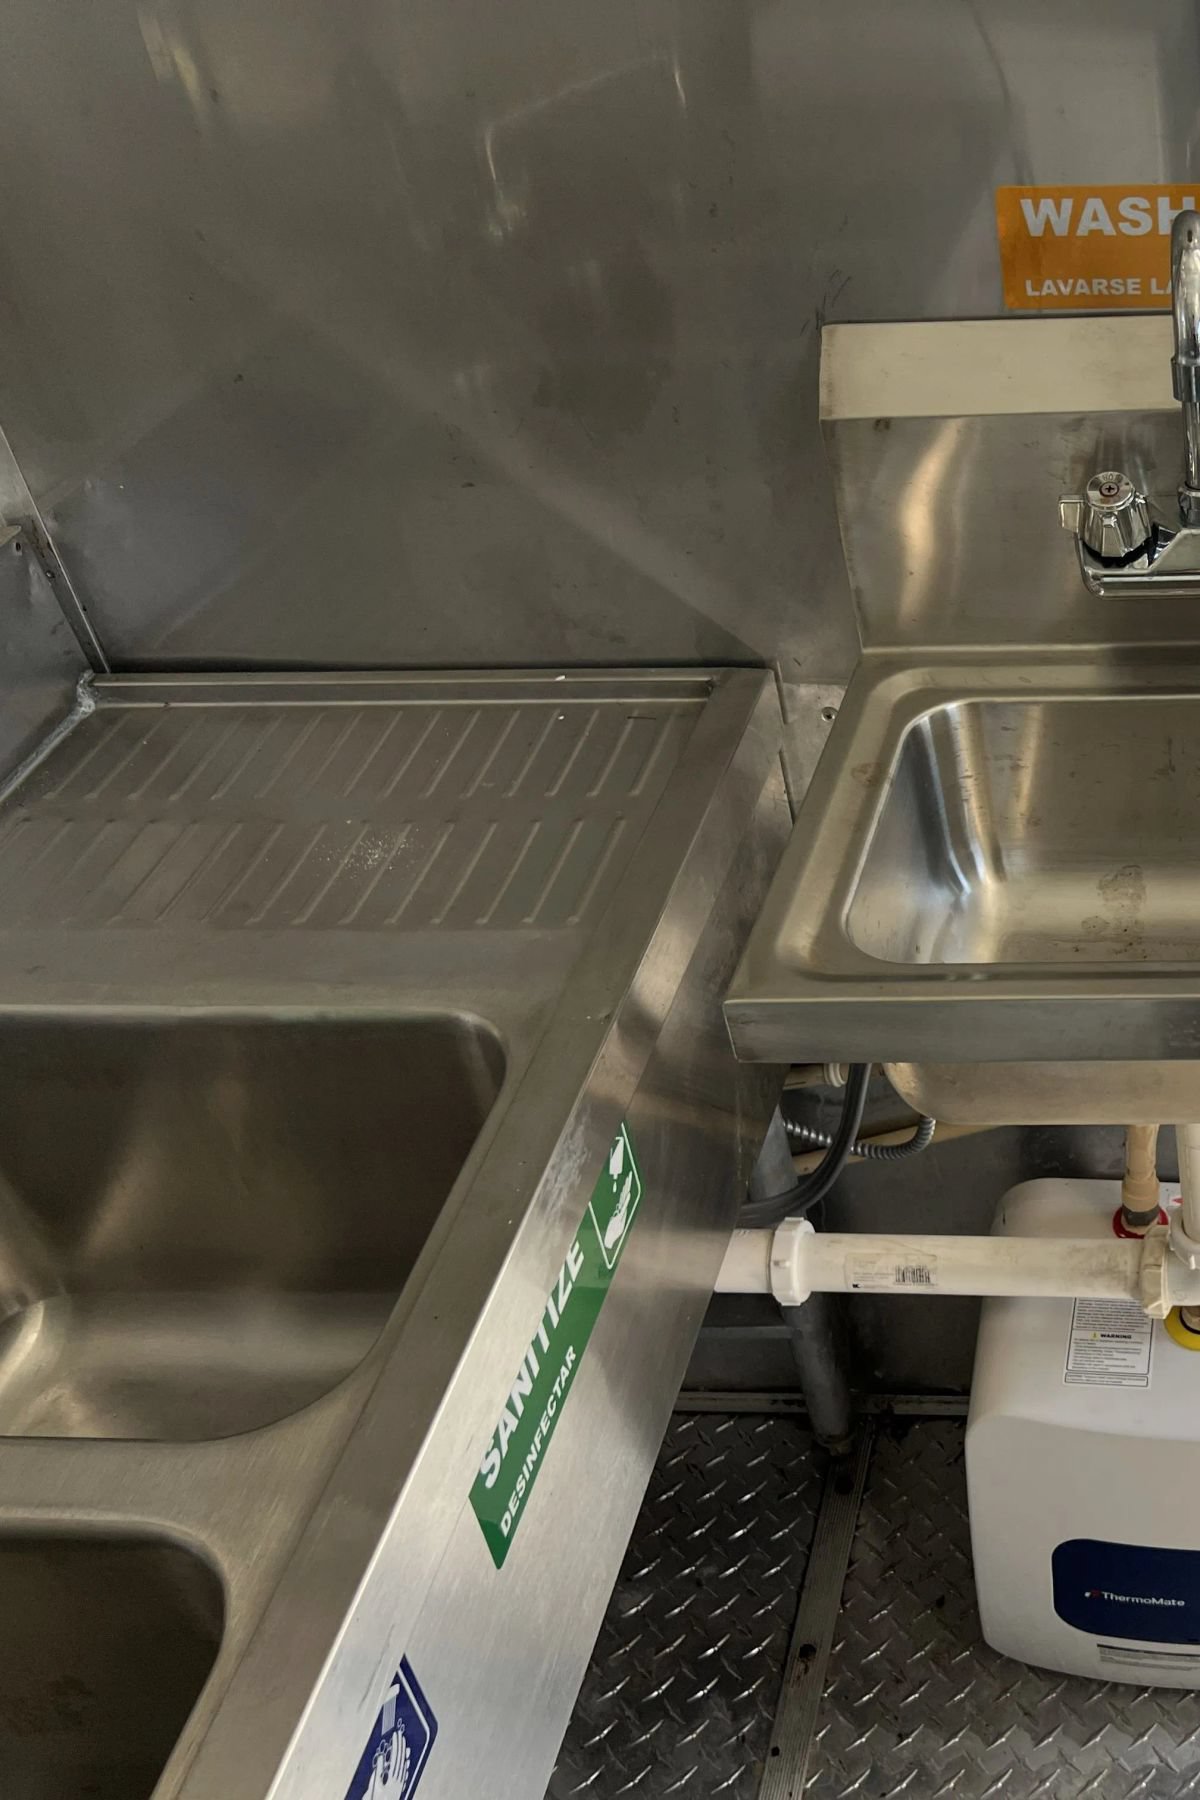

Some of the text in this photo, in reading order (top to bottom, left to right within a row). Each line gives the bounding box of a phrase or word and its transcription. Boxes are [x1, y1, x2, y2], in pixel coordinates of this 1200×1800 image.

[1020, 197, 1195, 237] WASH
[1025, 277, 1142, 297] LAVARSE
[480, 1239, 586, 1489] SANITIZE
[499, 1344, 577, 1539] DESINFECTAR
[1101, 1591, 1186, 1607] ThermoMate
